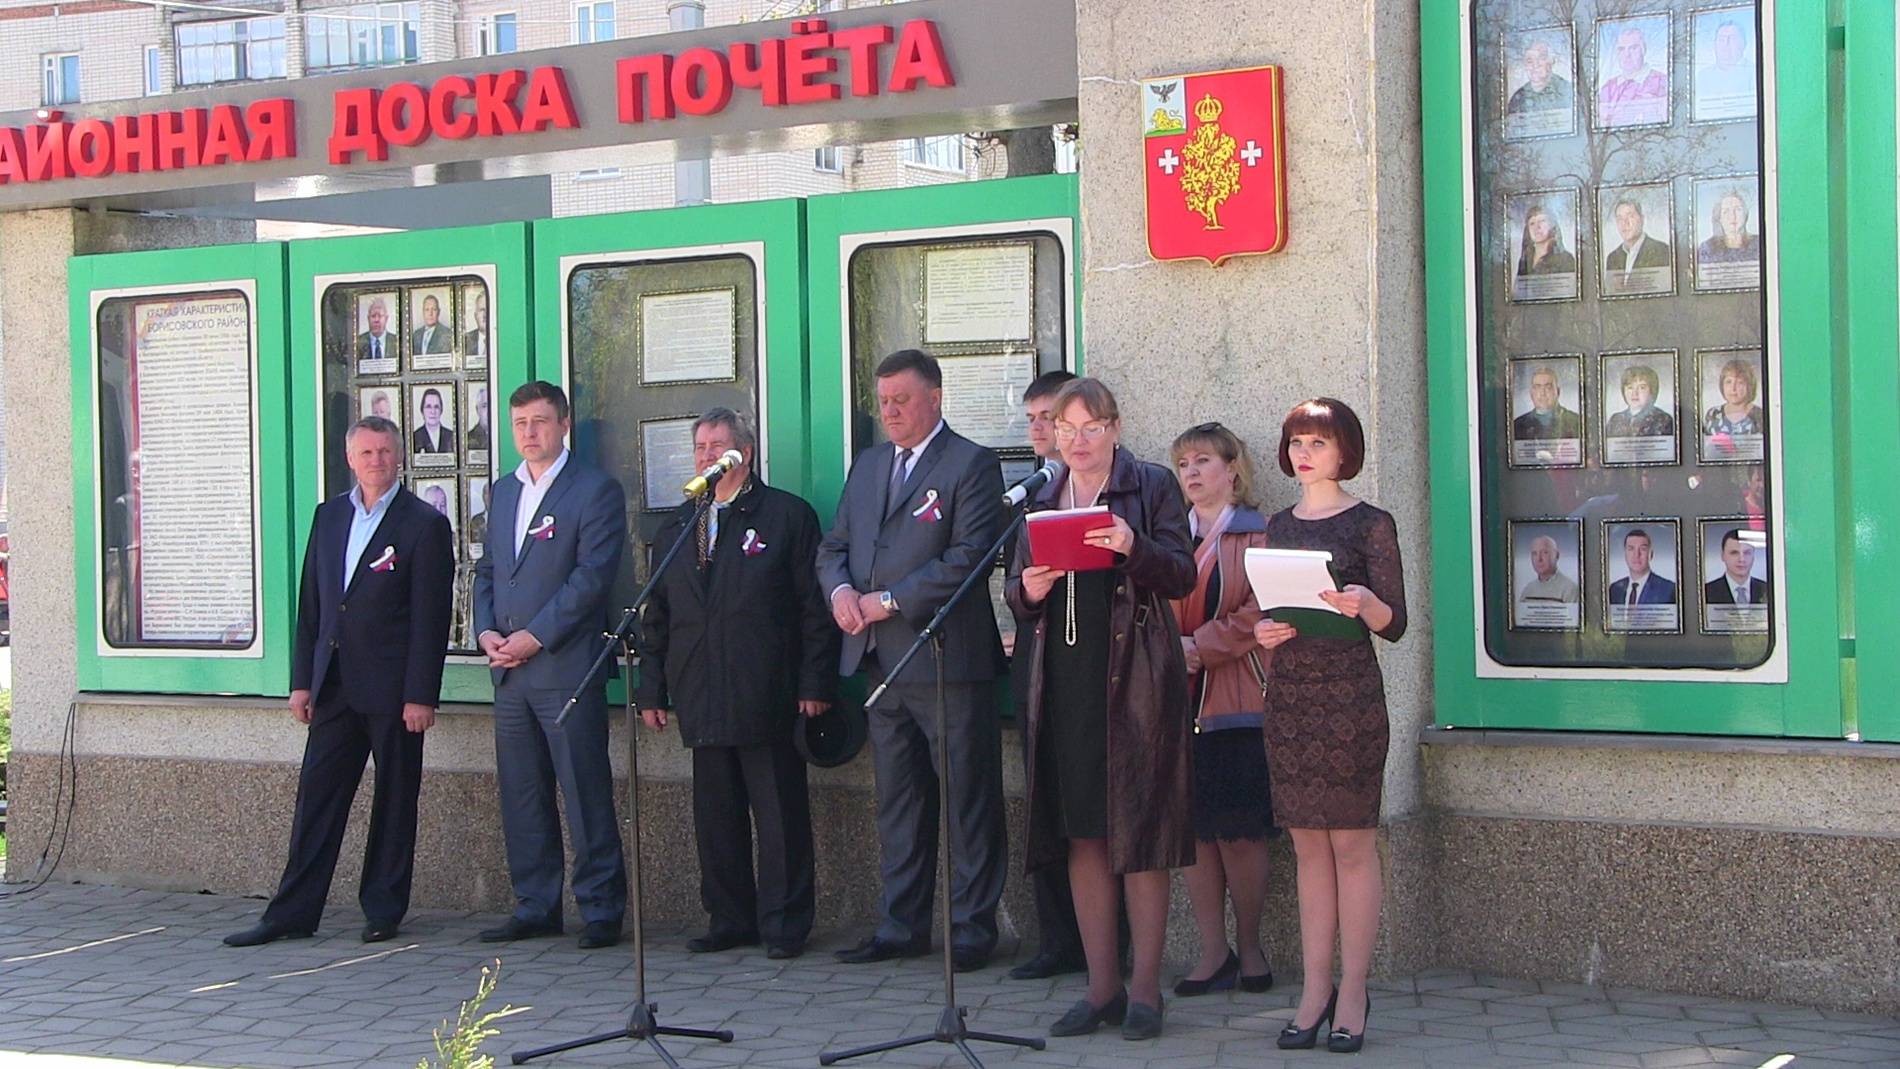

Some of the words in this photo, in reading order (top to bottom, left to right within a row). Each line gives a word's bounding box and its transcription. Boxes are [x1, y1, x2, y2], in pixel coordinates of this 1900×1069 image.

[0, 98, 296, 185] АЙОННАЯ
[328, 66, 580, 164] ДОСКА
[616, 19, 956, 124] ПОЧЁТА
